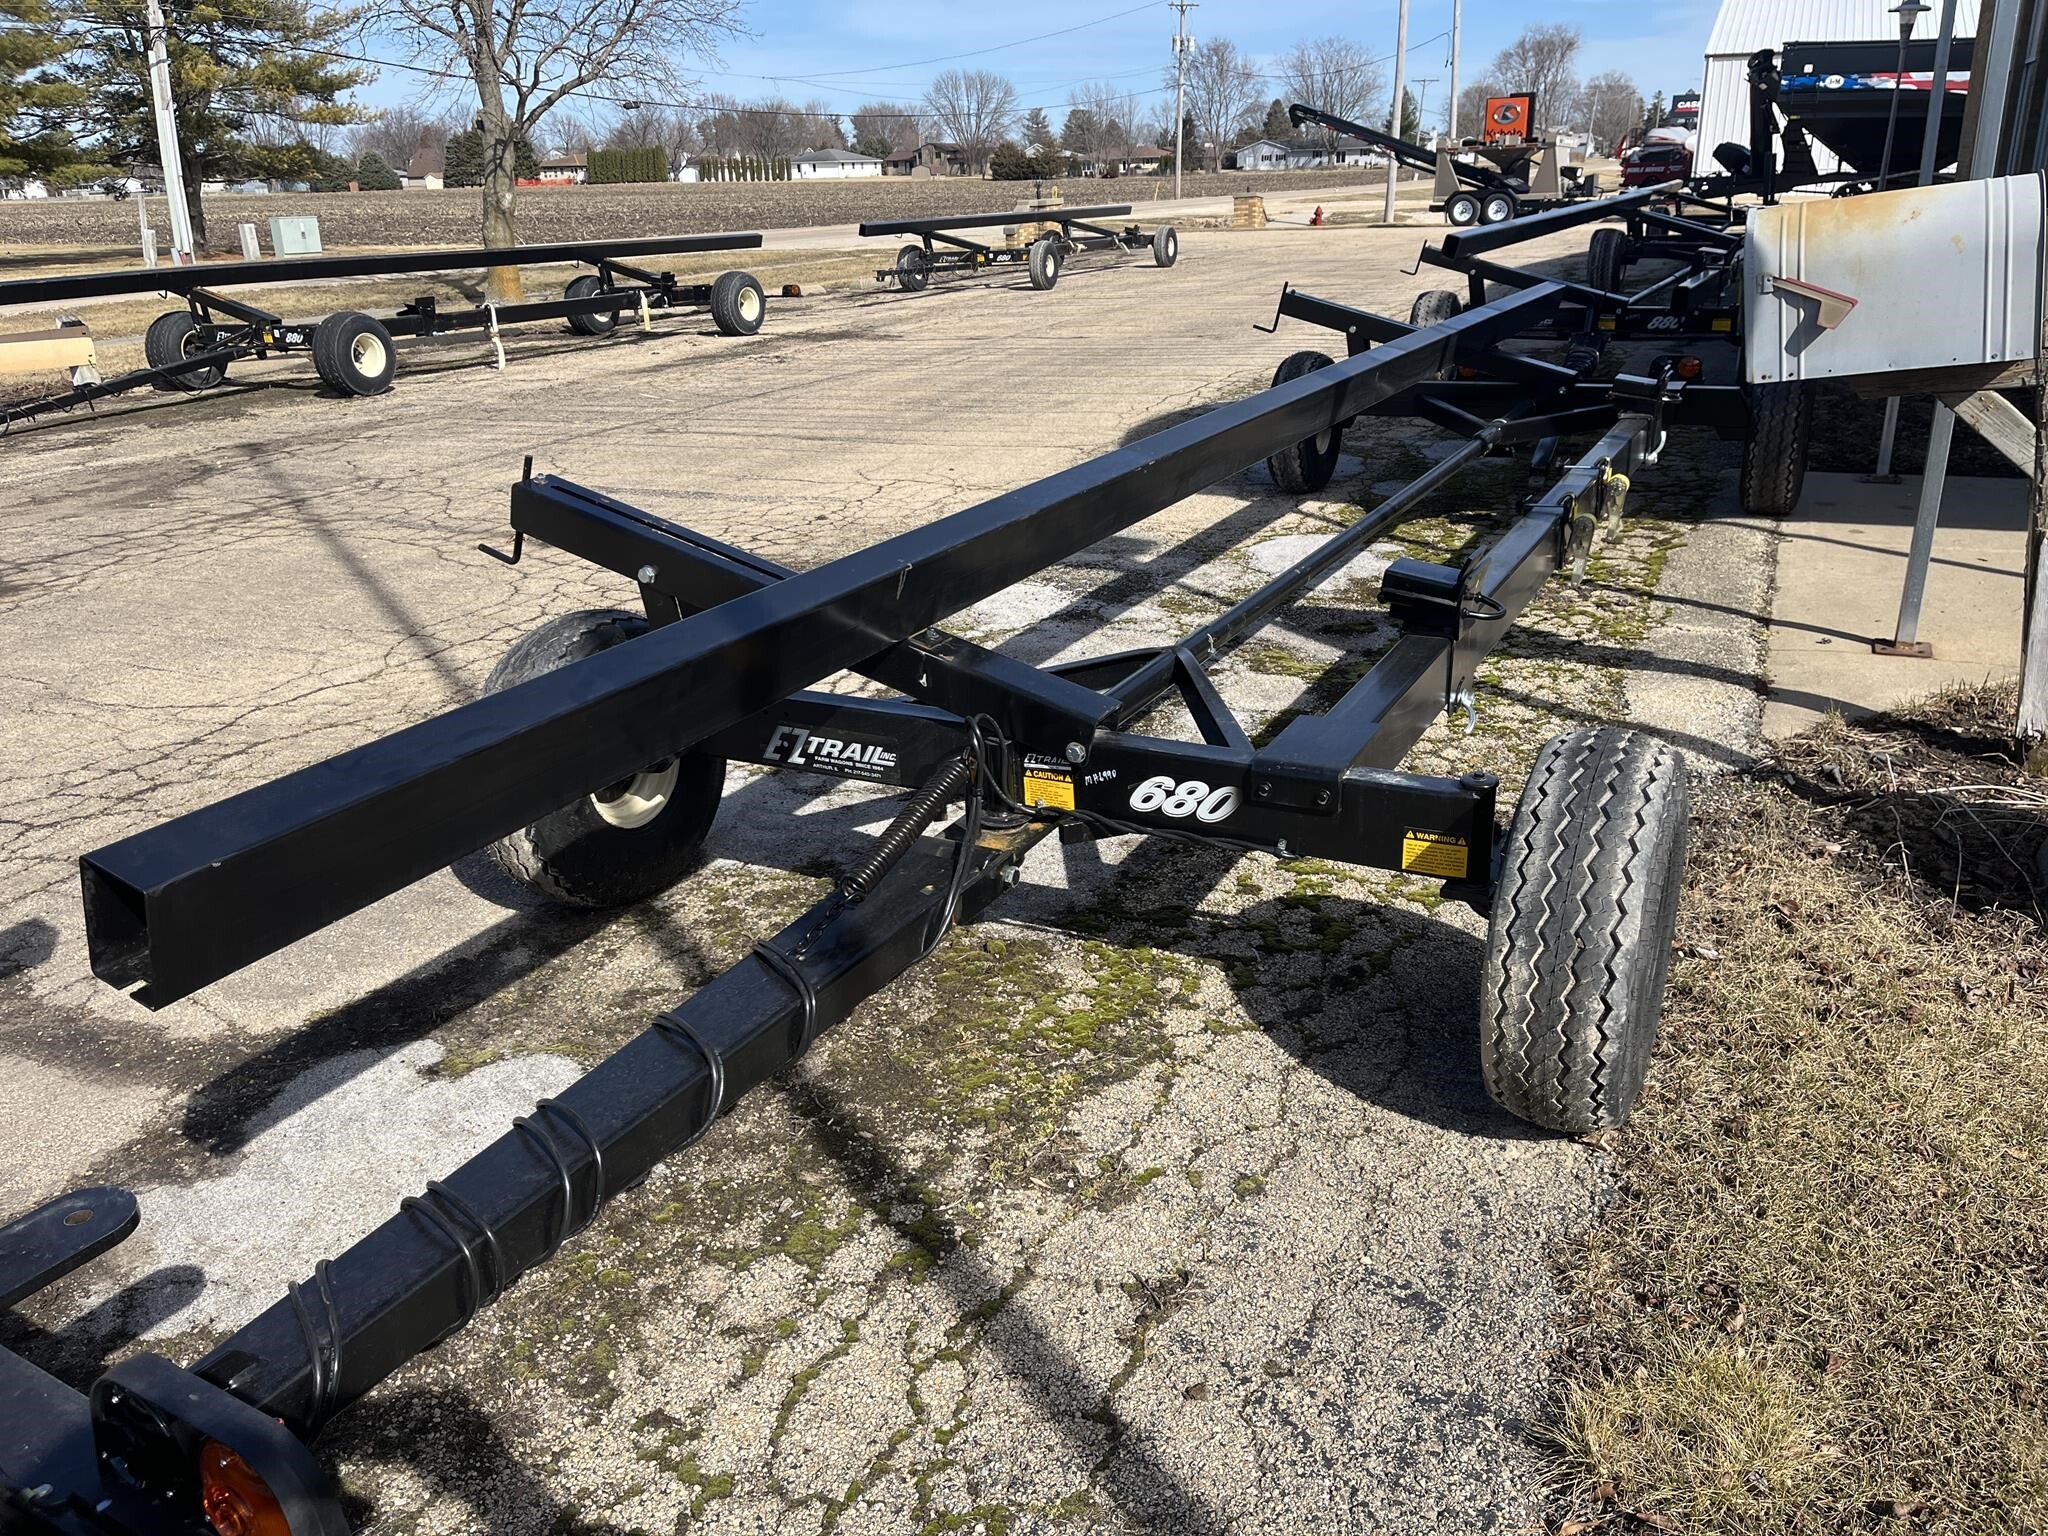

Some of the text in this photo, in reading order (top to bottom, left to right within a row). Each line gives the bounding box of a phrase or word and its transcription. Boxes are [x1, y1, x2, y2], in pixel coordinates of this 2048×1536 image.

[286, 332, 304, 343] 880
[807, 736, 896, 767] TRAIL
[1037, 755, 1071, 765] TRAIL
[1034, 770, 1064, 781] CAUTION
[1129, 775, 1242, 823] 680
[1416, 832, 1457, 844] WARNING
